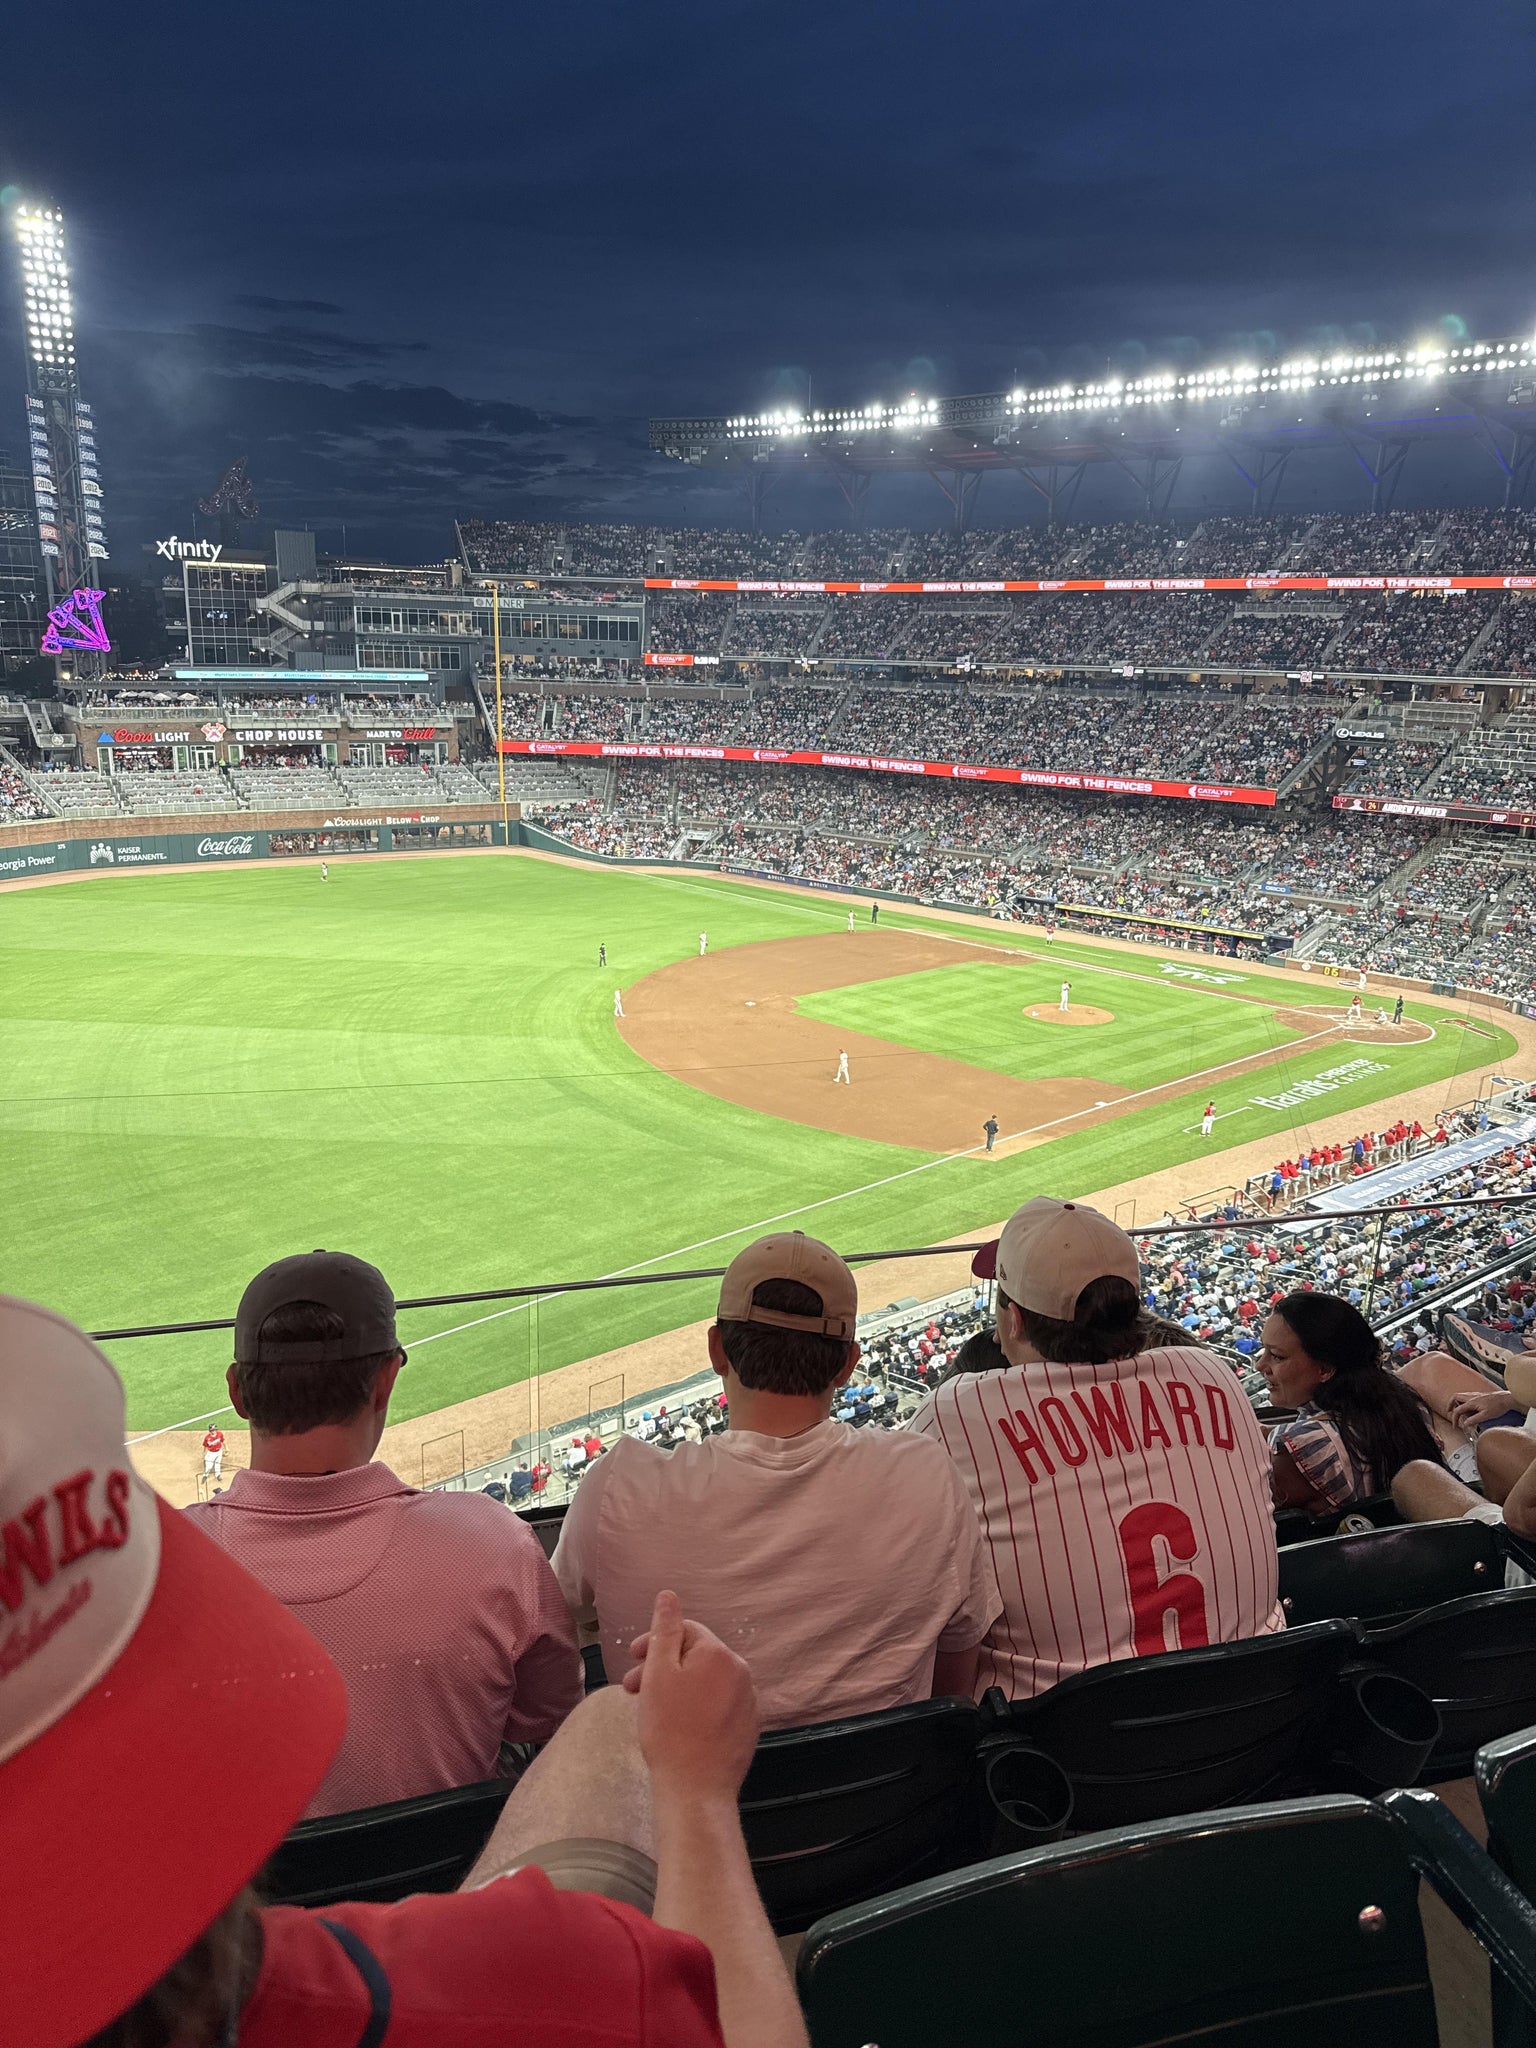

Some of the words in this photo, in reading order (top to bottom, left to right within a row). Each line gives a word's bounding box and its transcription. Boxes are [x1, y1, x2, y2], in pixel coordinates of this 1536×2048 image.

[80, 435, 94, 445] 2001
[34, 447, 48, 458] 2002
[82, 451, 96, 461] 2003
[36, 463, 50, 474] 2004
[83, 467, 97, 477] 2005
[38, 480, 52, 489] 2010
[85, 483, 98, 492] 2012
[40, 496, 52, 506] 2013
[86, 500, 99, 508] 2018
[88, 515, 101, 524] 2020
[42, 528, 56, 537] 2021
[89, 531, 102, 540] 2022
[90, 546, 104, 556] 2024
[156, 536, 222, 562] xfinity
[1104, 581, 1133, 589] SWING
[1133, 580, 1151, 588] FOR
[1152, 580, 1169, 588] THE
[1170, 580, 1205, 588] FENCES
[1327, 579, 1361, 588] SWING
[1363, 579, 1385, 588] FOR
[1387, 579, 1408, 588] THE
[1408, 579, 1452, 587] FENCES
[114, 728, 154, 742] Coors
[155, 732, 190, 742] LIGHT
[235, 731, 274, 741] CHOP
[278, 730, 323, 740] HOUSE
[403, 728, 436, 740] Chill
[602, 746, 638, 754] SWING
[639, 747, 660, 755] FOR
[663, 748, 684, 756] THE
[685, 749, 724, 758] FENCES
[822, 755, 850, 765] SWING
[851, 758, 868, 767] FOR
[871, 760, 888, 769] THE
[889, 762, 924, 772] FENCES
[1020, 773, 1056, 783] SWING
[1058, 776, 1080, 785] FOR
[1084, 778, 1105, 788] THE
[1106, 780, 1152, 792] FENCES
[1197, 788, 1234, 796] CATALYST
[386, 816, 412, 824] BELOW
[1492, 813, 1507, 822] RHP
[197, 836, 255, 856] Coca-Cola
[0, 858, 26, 870] eorgia
[28, 856, 56, 866] Power
[1333, 1062, 1391, 1084] CASINOS
[998, 1380, 1234, 1484] HOWARD
[1118, 1501, 1210, 1657] 6
